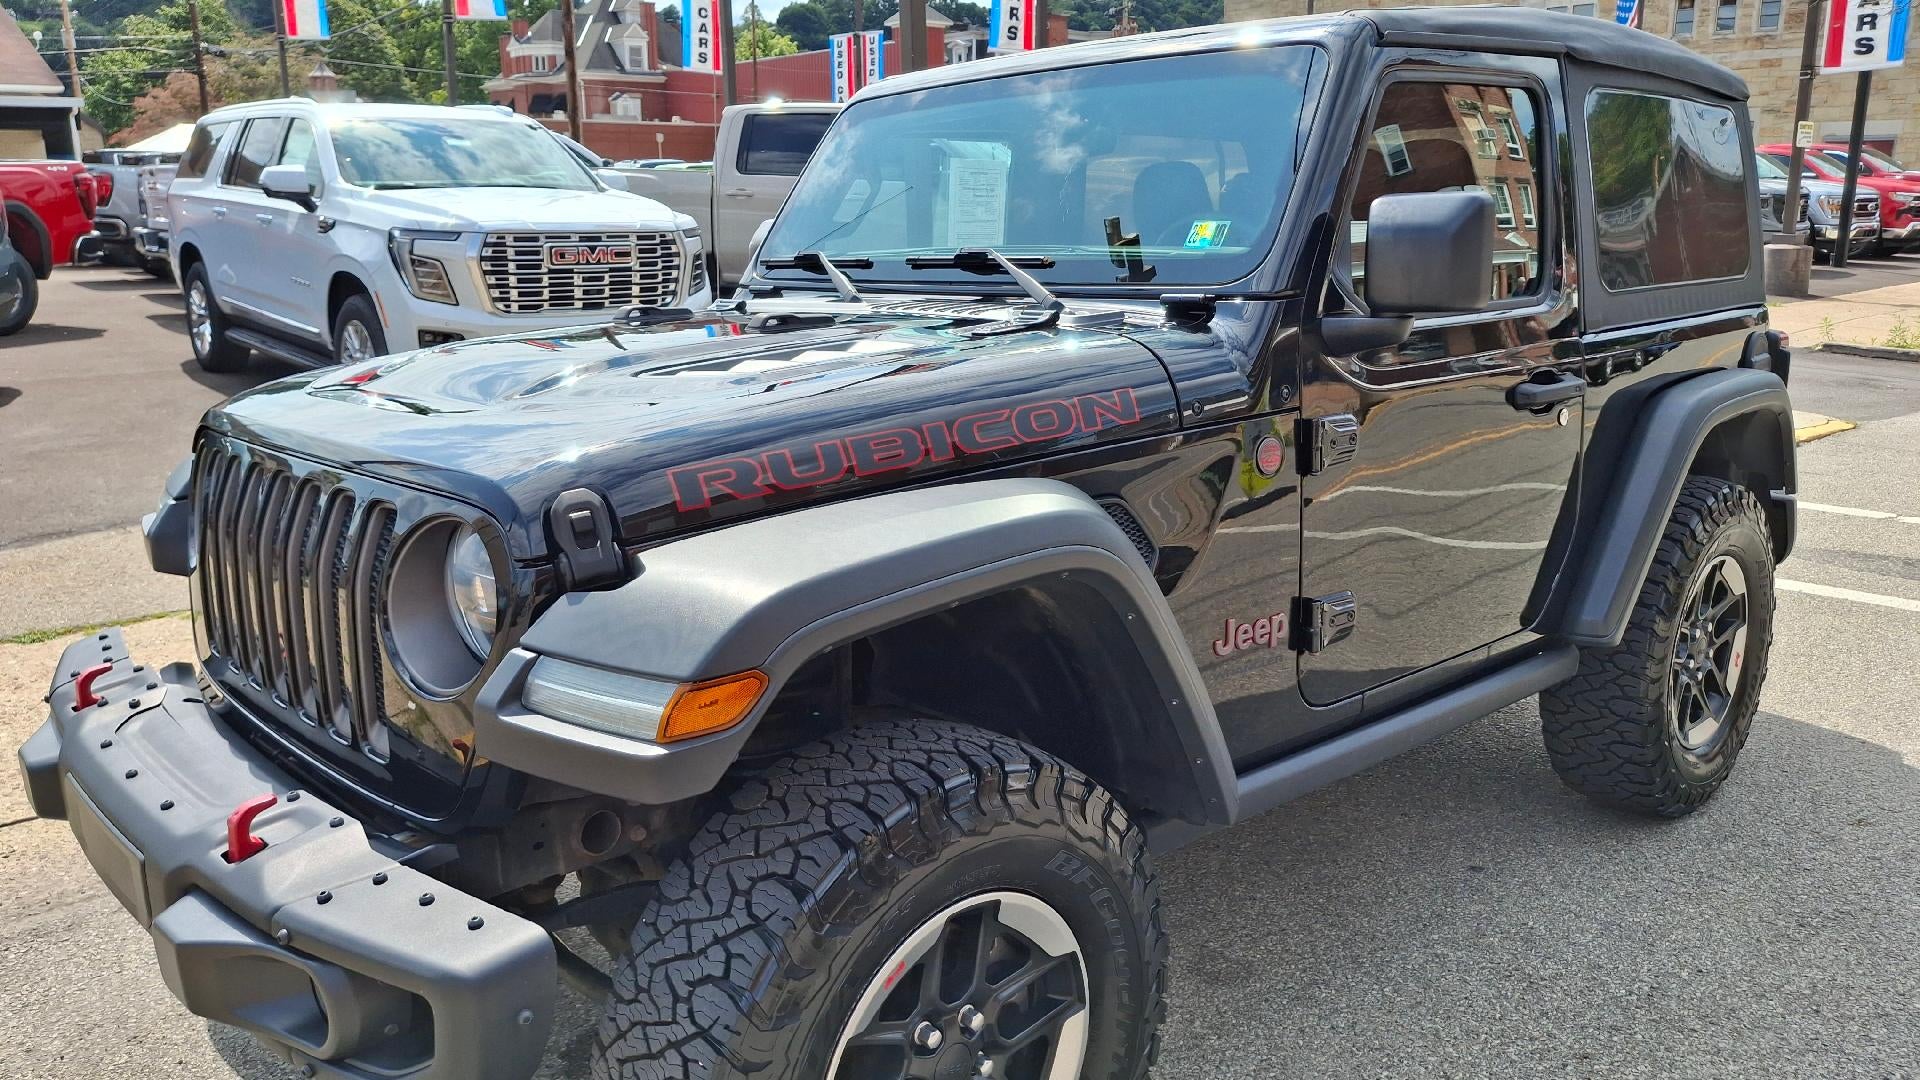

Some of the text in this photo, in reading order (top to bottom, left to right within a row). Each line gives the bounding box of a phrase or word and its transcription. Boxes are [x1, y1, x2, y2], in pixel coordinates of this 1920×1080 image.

[697, 7, 709, 64] CARS
[1006, 0, 1020, 41] RS
[836, 39, 844, 79] USED
[868, 35, 876, 77] USED
[551, 246, 632, 264] GMC
[666, 387, 1141, 512] RUBICON
[1212, 612, 1289, 656] Jeep
